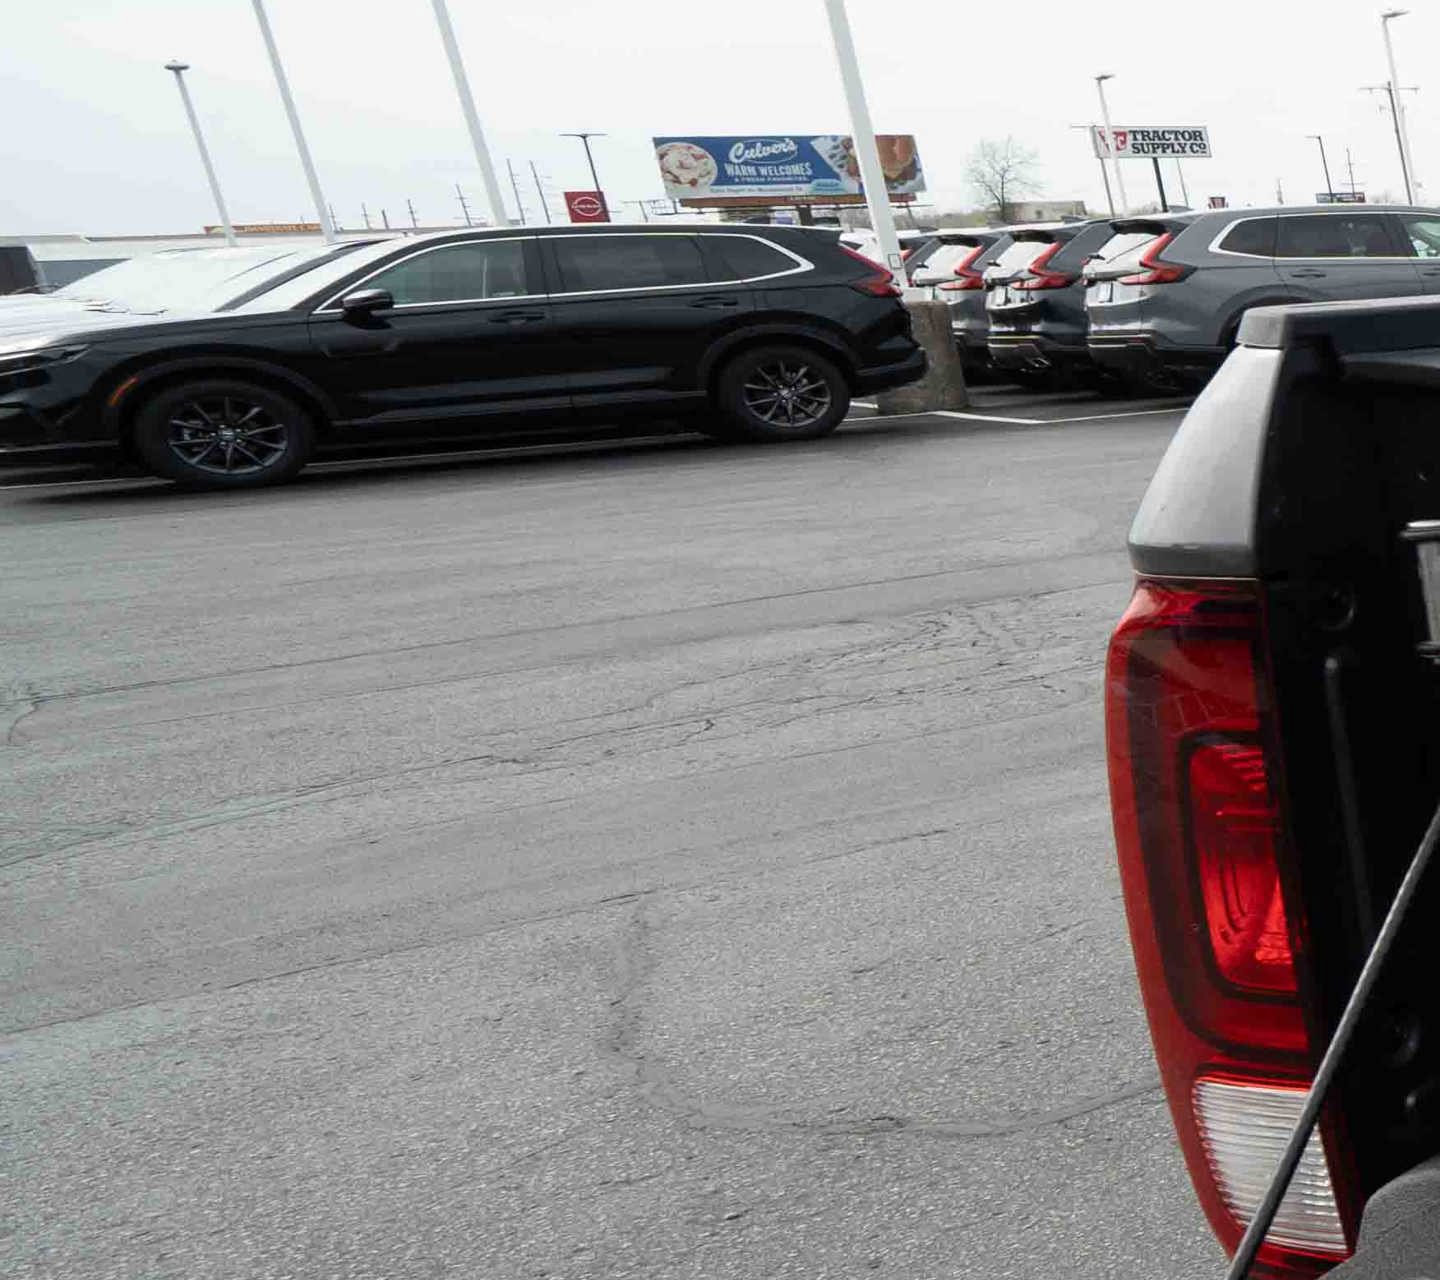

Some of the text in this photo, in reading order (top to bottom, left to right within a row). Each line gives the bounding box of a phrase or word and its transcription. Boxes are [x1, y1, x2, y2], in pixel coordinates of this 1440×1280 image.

[1128, 130, 1204, 142] TRACTOR
[729, 138, 795, 163] Culver's
[1131, 142, 1188, 154] SUPPLY
[725, 162, 812, 176] WARM WELCOMES
